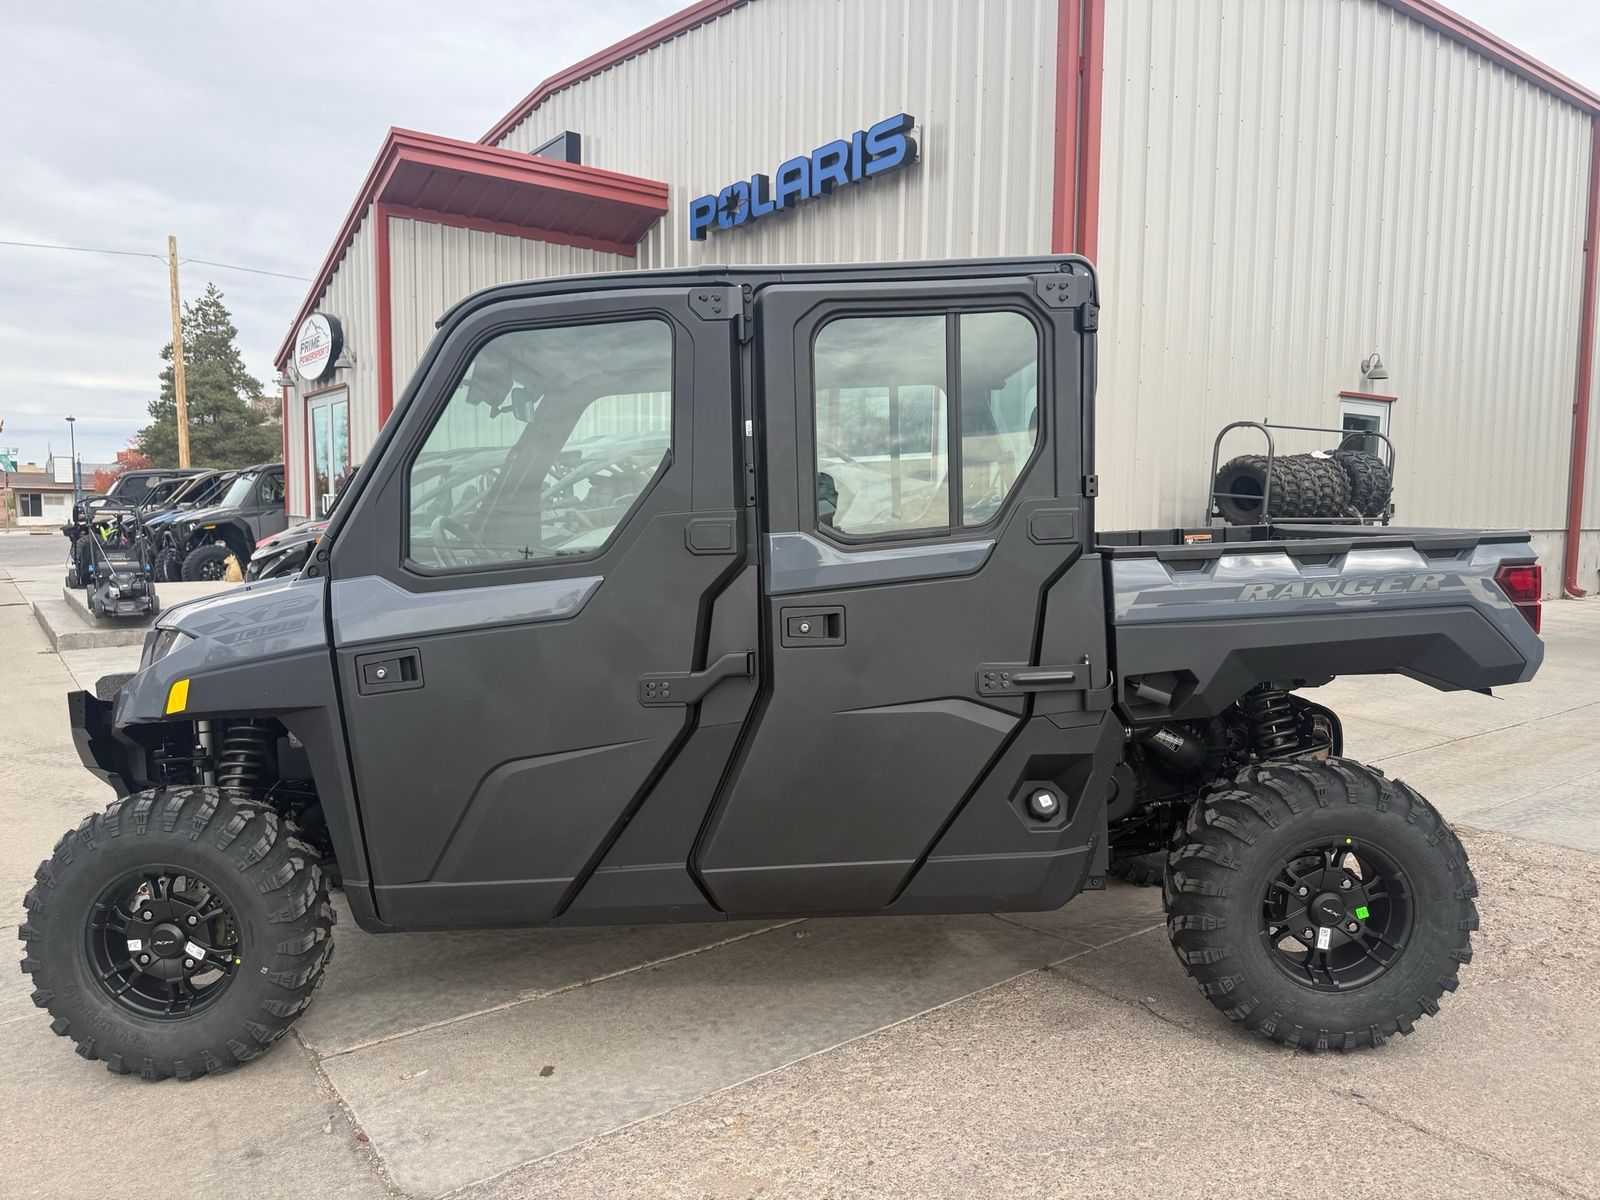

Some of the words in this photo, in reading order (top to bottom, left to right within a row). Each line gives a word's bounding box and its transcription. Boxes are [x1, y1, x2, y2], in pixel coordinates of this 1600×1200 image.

[690, 113, 911, 240] POLARIS
[299, 344, 330, 364] POWERSPORTS
[300, 336, 320, 355] PRIME
[1238, 573, 1447, 601] RANGER
[209, 594, 319, 634] XP
